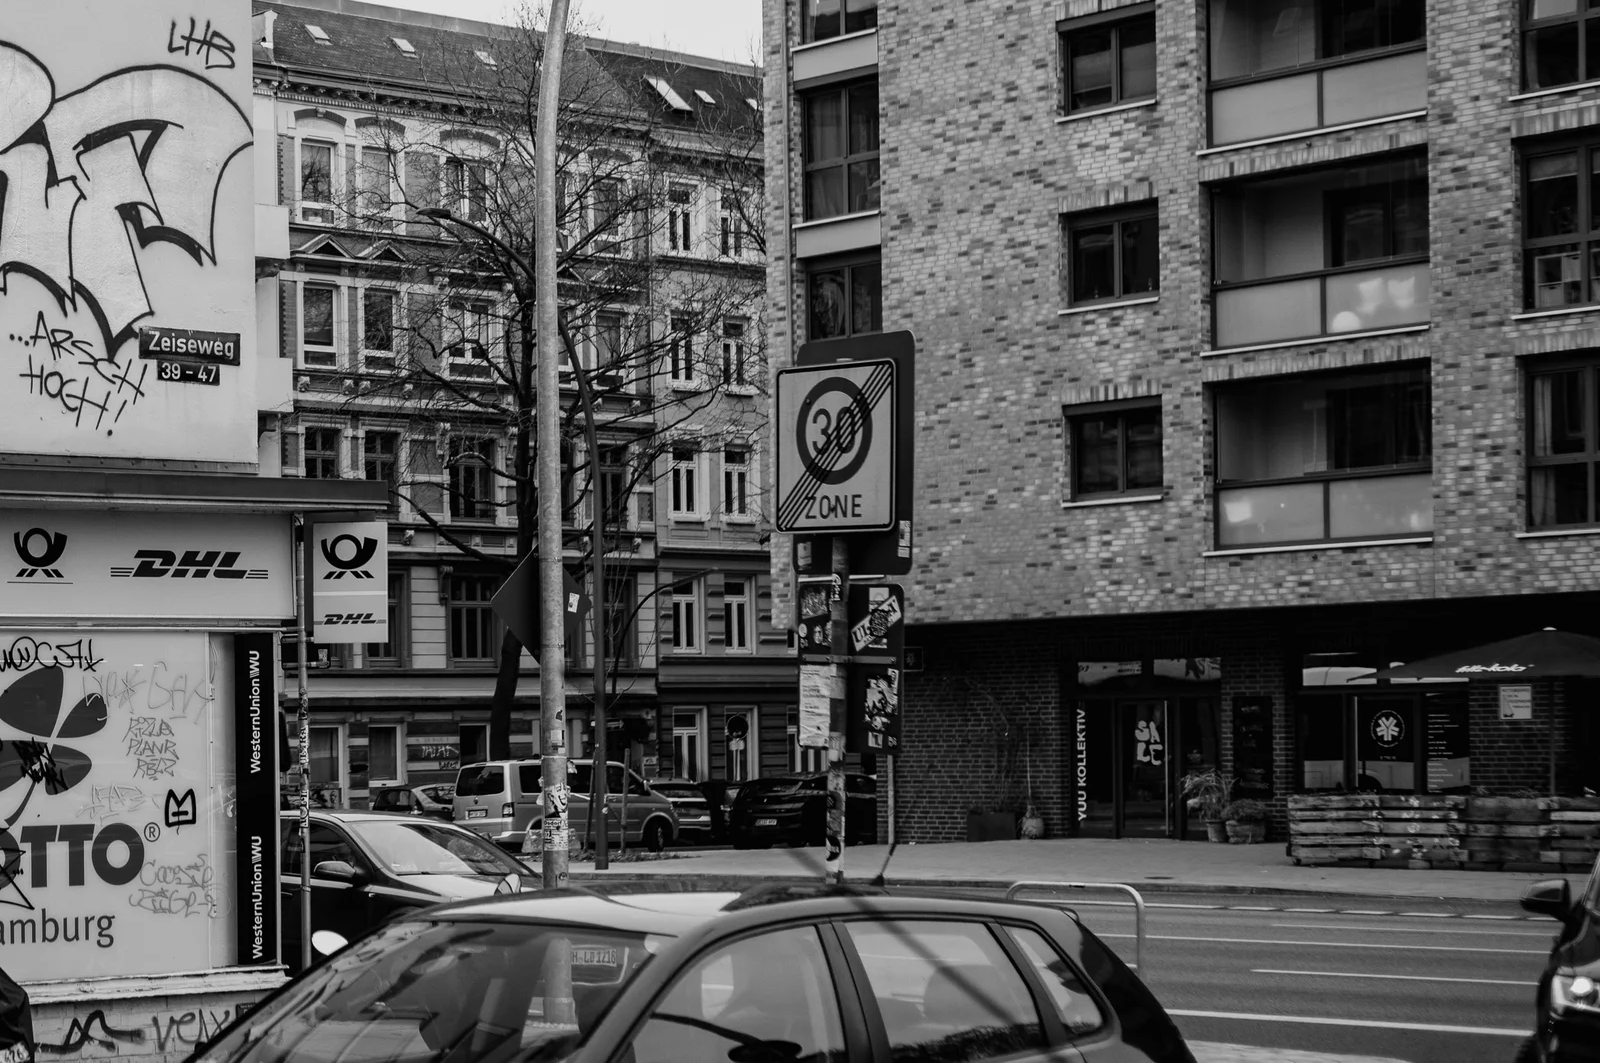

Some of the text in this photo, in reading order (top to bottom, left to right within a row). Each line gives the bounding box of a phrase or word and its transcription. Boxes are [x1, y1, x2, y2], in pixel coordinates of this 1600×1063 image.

[148, 330, 234, 360] Zeiseweg
[161, 362, 181, 380] 39
[197, 365, 217, 383] 47
[812, 406, 856, 456] 30
[804, 494, 862, 520] ZONE
[131, 549, 252, 580] DHL
[323, 612, 378, 626] DHL
[1076, 709, 1087, 821] YUU KOLLEKTIV
